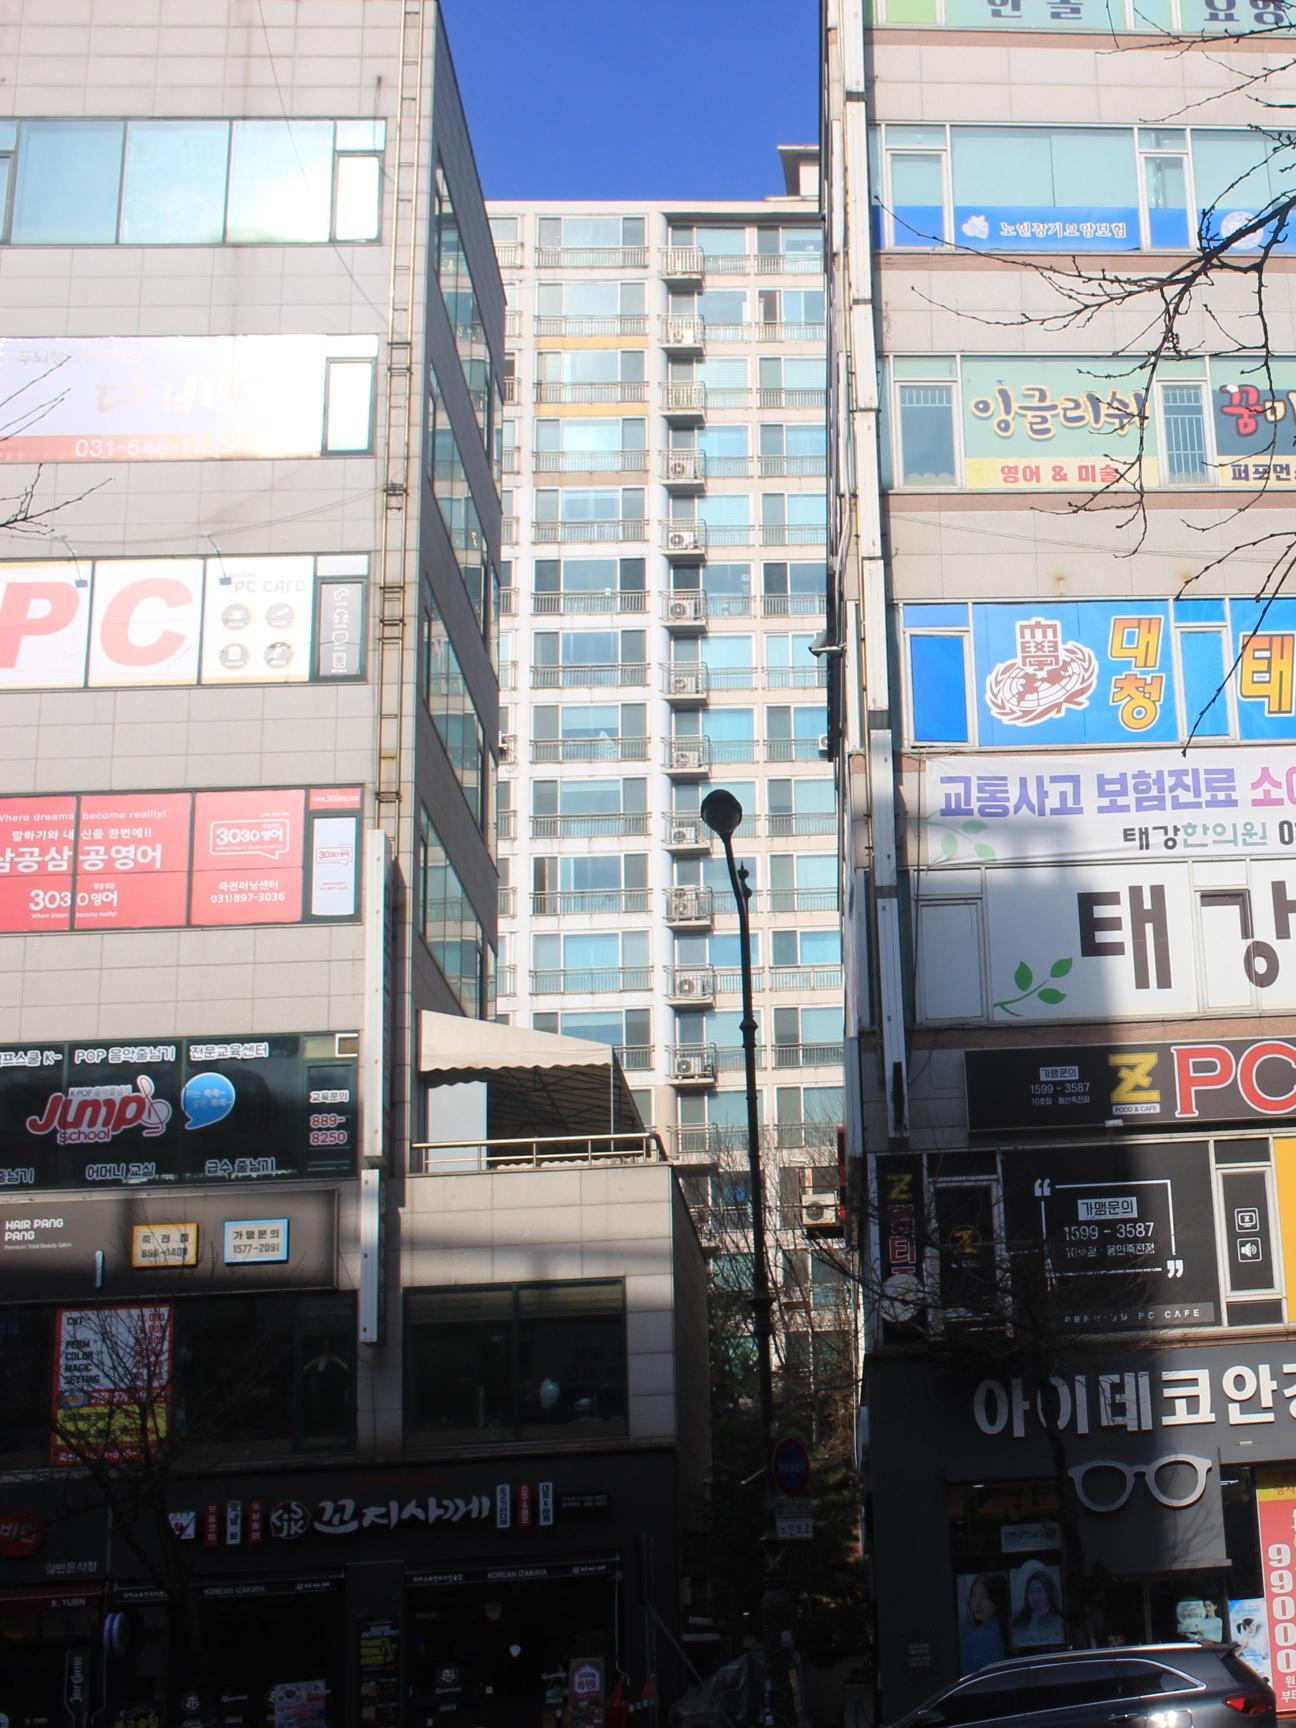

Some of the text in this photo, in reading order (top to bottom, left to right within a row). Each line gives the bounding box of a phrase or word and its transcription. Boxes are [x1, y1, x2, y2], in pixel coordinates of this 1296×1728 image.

[971, 384, 1150, 440] 잉글리쉬
[1000, 464, 1041, 483] 영어
[1051, 465, 1069, 482] &
[1110, 616, 1165, 732] 대청
[939, 774, 1084, 817] 교통사고
[1096, 768, 1238, 813] 보험진료
[33, 812, 75, 822] dreams
[83, 811, 128, 821] become
[1123, 821, 1268, 850] 태강한의원
[109, 1042, 269, 1063] 음악줄넘기 전문교육센터
[310, 1089, 350, 1104] 교육문의
[58, 1128, 112, 1144] school
[310, 1131, 347, 1145] 8250
[86, 1162, 127, 1181] 어머니
[128, 1161, 156, 1179] 교실
[235, 1157, 277, 1175] 줄넘기
[1081, 1201, 1135, 1218] 가맹문의
[5, 1218, 64, 1231] HAIR PANG
[5, 1230, 35, 1242] PANG
[233, 1229, 280, 1241] 가맹문의
[1164, 1308, 1201, 1320] CAFE
